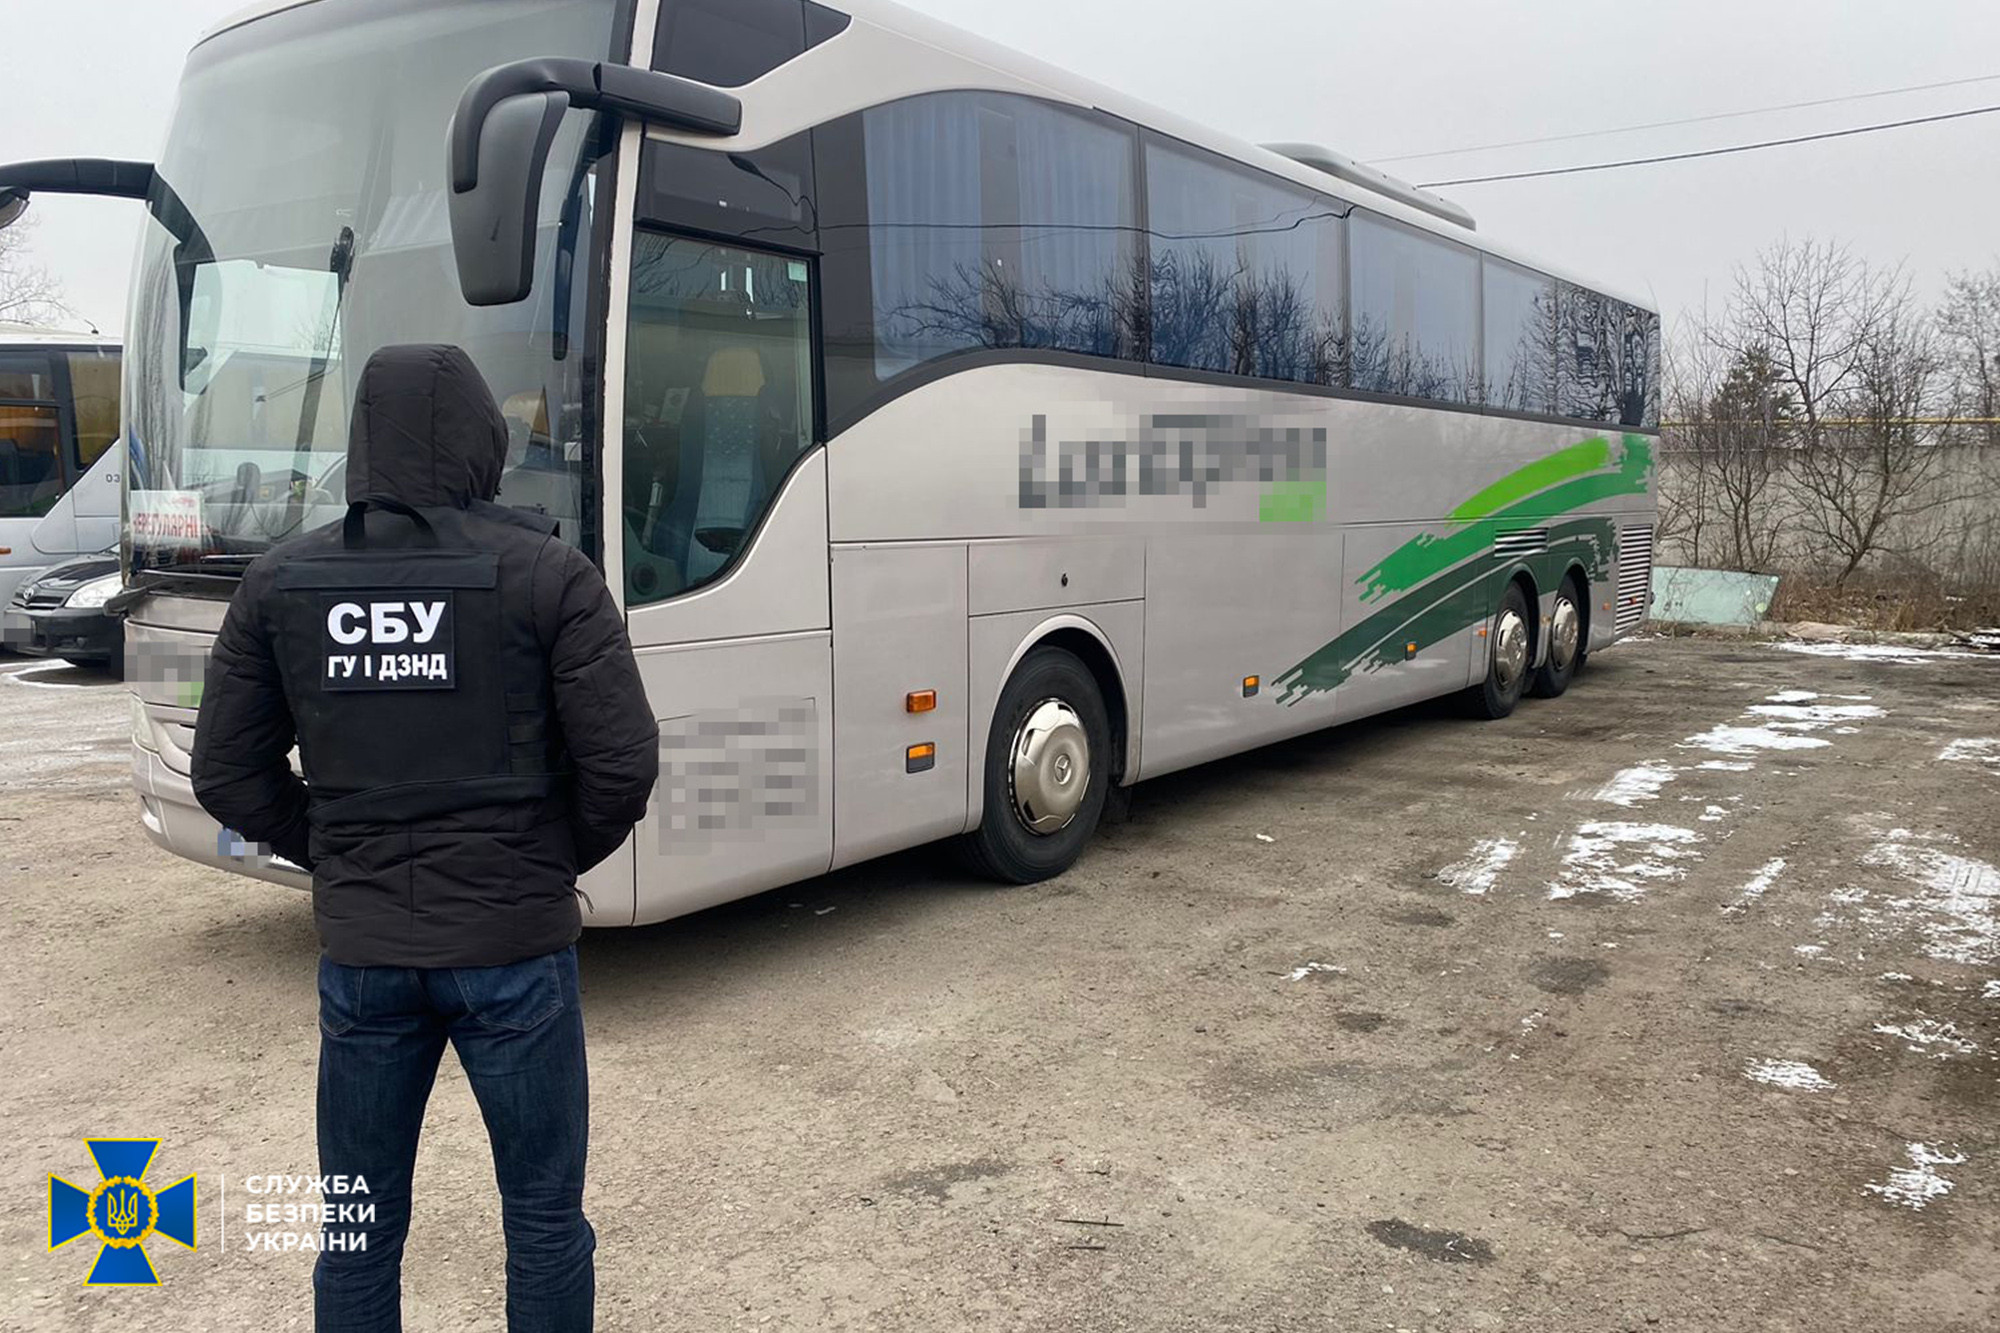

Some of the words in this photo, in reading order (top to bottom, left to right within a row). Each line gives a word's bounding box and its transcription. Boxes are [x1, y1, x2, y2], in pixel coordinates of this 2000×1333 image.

[327, 602, 446, 645] СБУ
[328, 655, 357, 678] ГУ
[364, 655, 372, 677] І
[379, 653, 448, 681] ДЗНД
